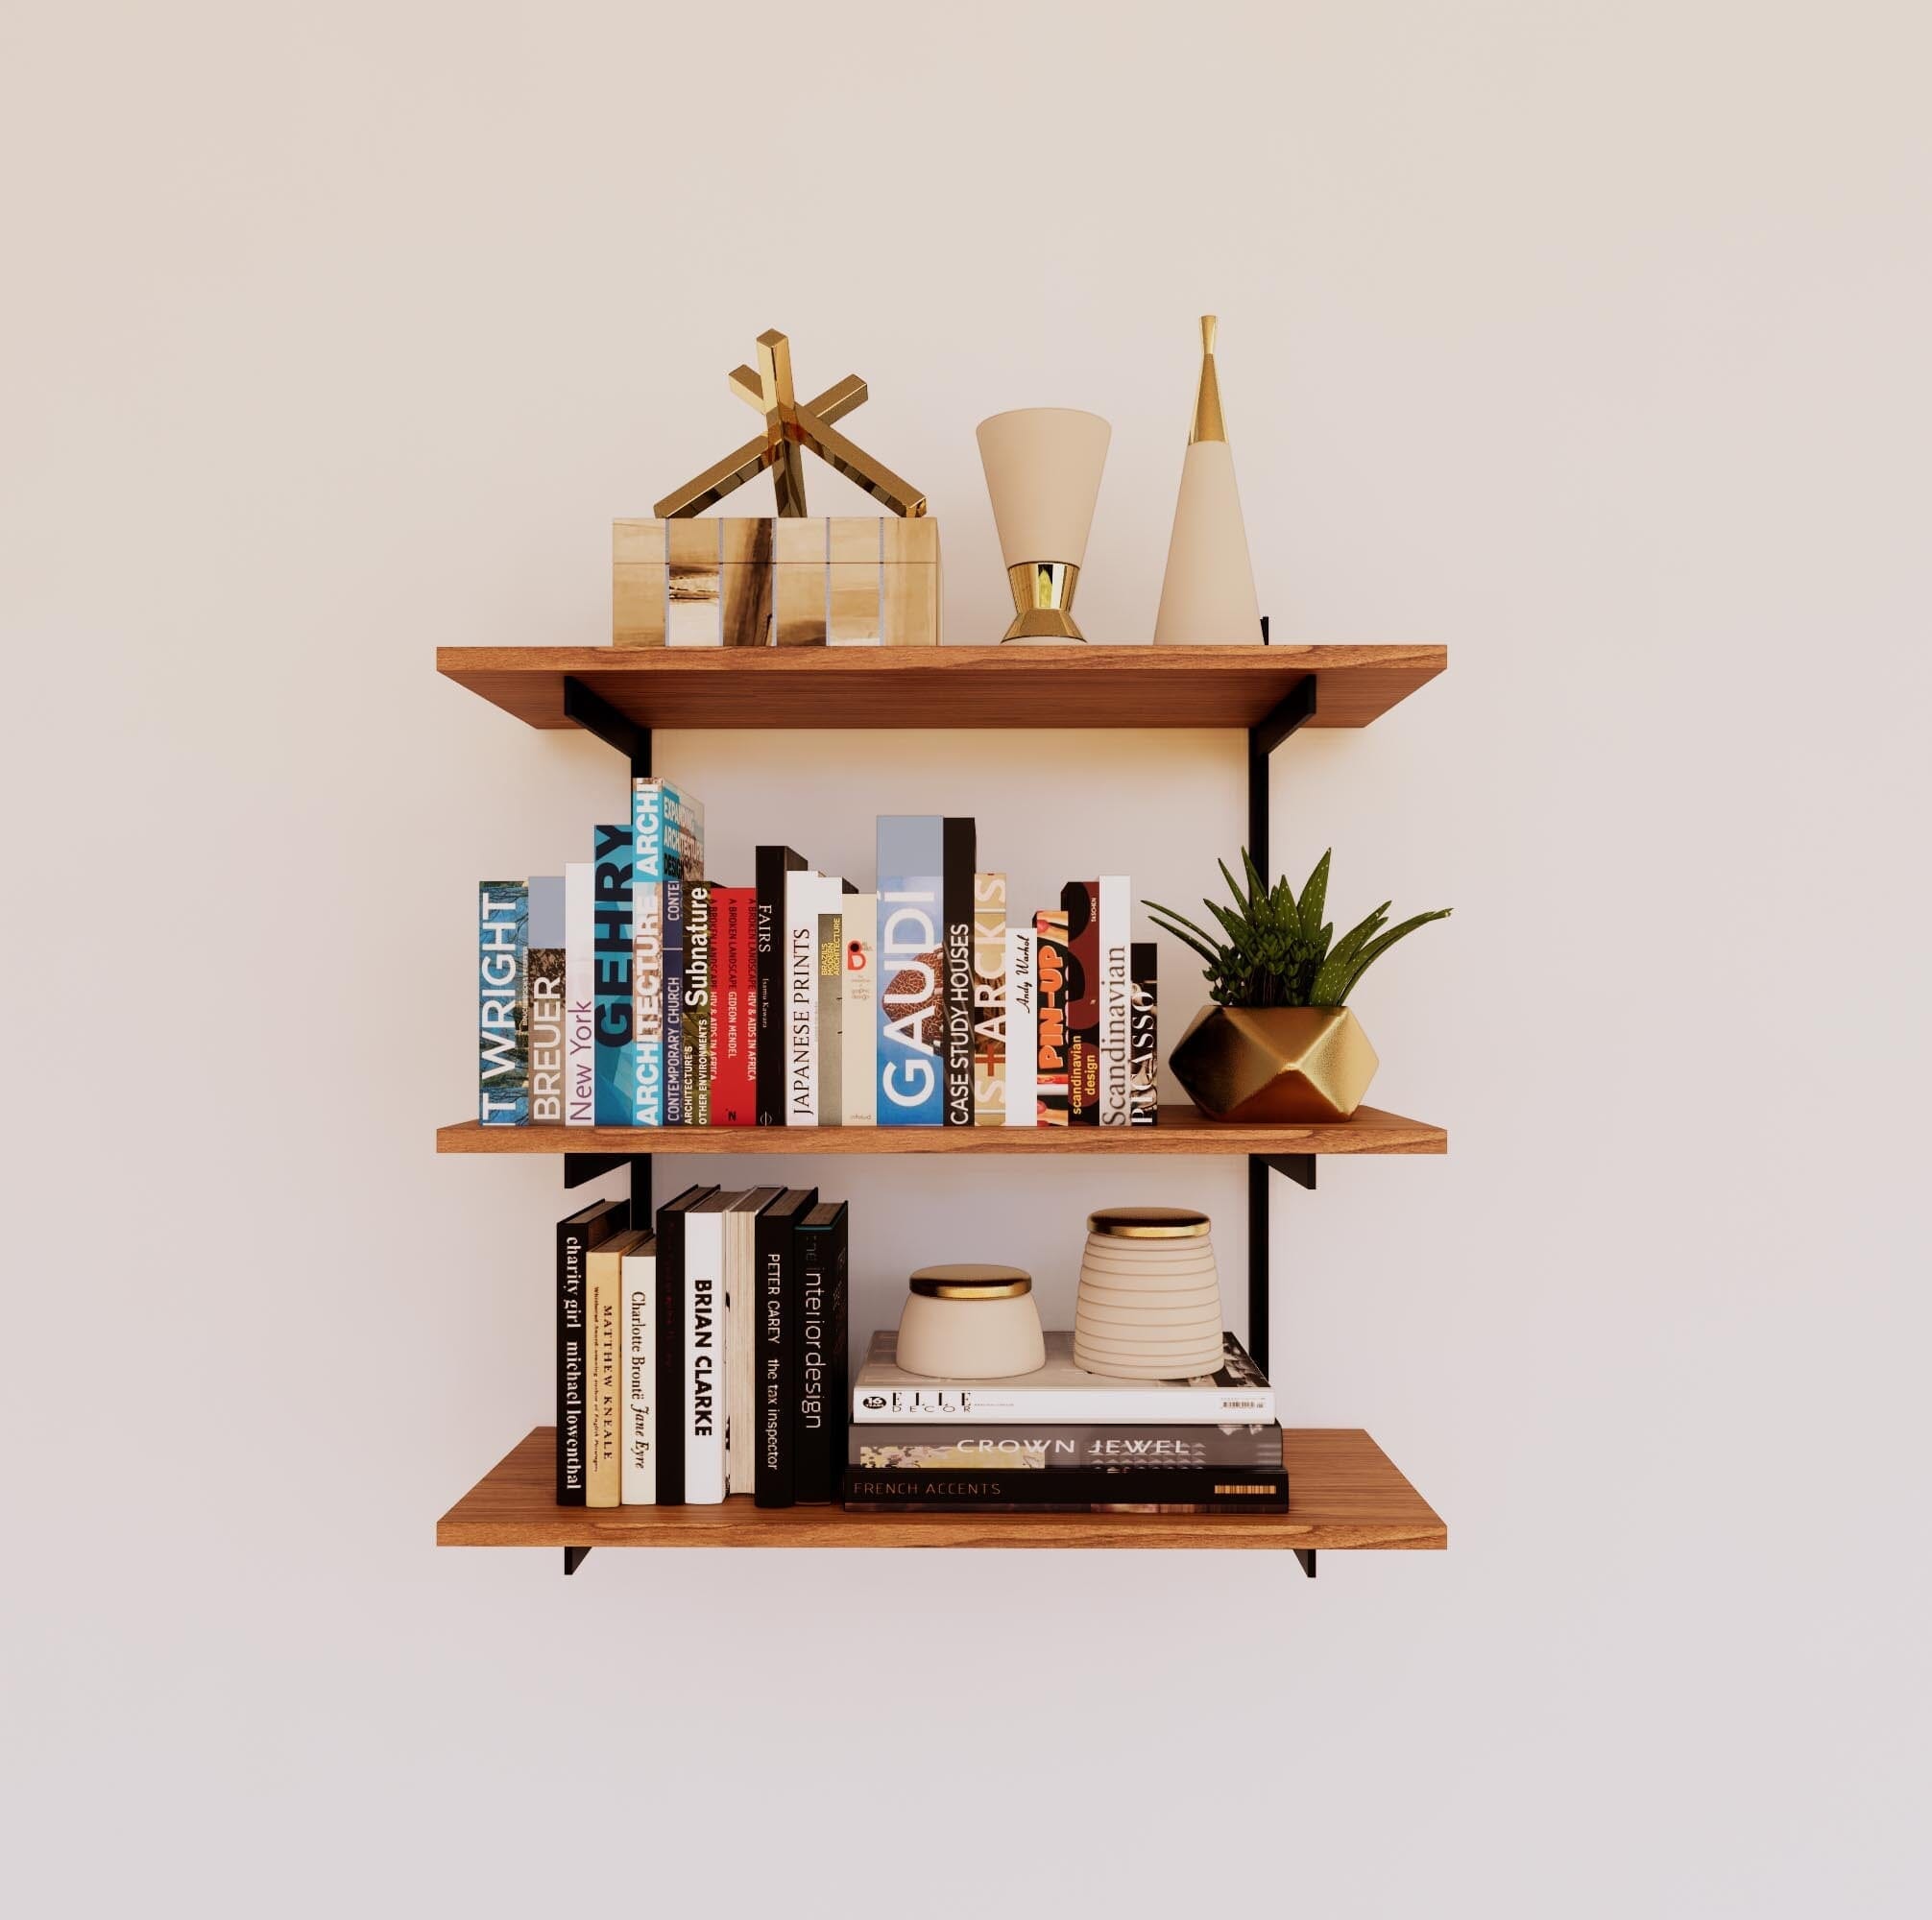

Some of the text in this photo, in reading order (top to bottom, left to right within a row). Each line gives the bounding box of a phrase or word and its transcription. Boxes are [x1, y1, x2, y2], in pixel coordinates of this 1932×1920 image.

[594, 825, 633, 1048] GEHRY
[685, 886, 708, 1007] Subnature
[728, 906, 737, 939] BROKEN
[728, 941, 737, 989] LANDSCAPE
[748, 941, 757, 989] LANDSCAPE
[759, 904, 772, 953] FAIRS
[1015, 934, 1032, 1014] Andy Warhol
[481, 892, 516, 1080] WRIGHT
[636, 892, 660, 1126] ARCHITECTURE
[728, 991, 737, 1023] GIDEON
[747, 991, 756, 1006] HIV
[747, 1017, 756, 1038] AIDS
[793, 928, 814, 1115] JAPANESE PRINTS
[951, 924, 969, 1125] CASE STUDY HOUSES
[1038, 945, 1064, 1069] PIN-UP
[1100, 946, 1125, 1125] Scandinavian
[533, 976, 561, 1120] BREUER
[568, 1000, 592, 1120] New York
[667, 977, 680, 1121] CONTEMPORARY CHURCH
[698, 1019, 708, 1125] OTHER ENVIRONMENTS
[728, 1025, 737, 1059] MENDEL
[747, 1039, 756, 1049] IN
[747, 1050, 756, 1081] AFRICA
[1071, 1035, 1082, 1115] scandinavian
[1084, 1054, 1098, 1095] design
[1130, 991, 1154, 1123] PICASSO
[564, 1236, 581, 1489] charity girl michael lowenthal
[603, 1306, 613, 1460] MATTHEW KNEALE
[630, 1291, 649, 1469] Charlotte Brontë Jane Eyre
[694, 1280, 712, 1436] BRIAN CLARKE
[765, 1254, 781, 1471] PETER CAREY the tax inspector
[802, 1352, 827, 1428] design
[892, 1391, 972, 1406] ELLE
[854, 1482, 1001, 1495] FRENCH ACCENTS
[956, 1439, 1190, 1453] CROWN JEWEL
